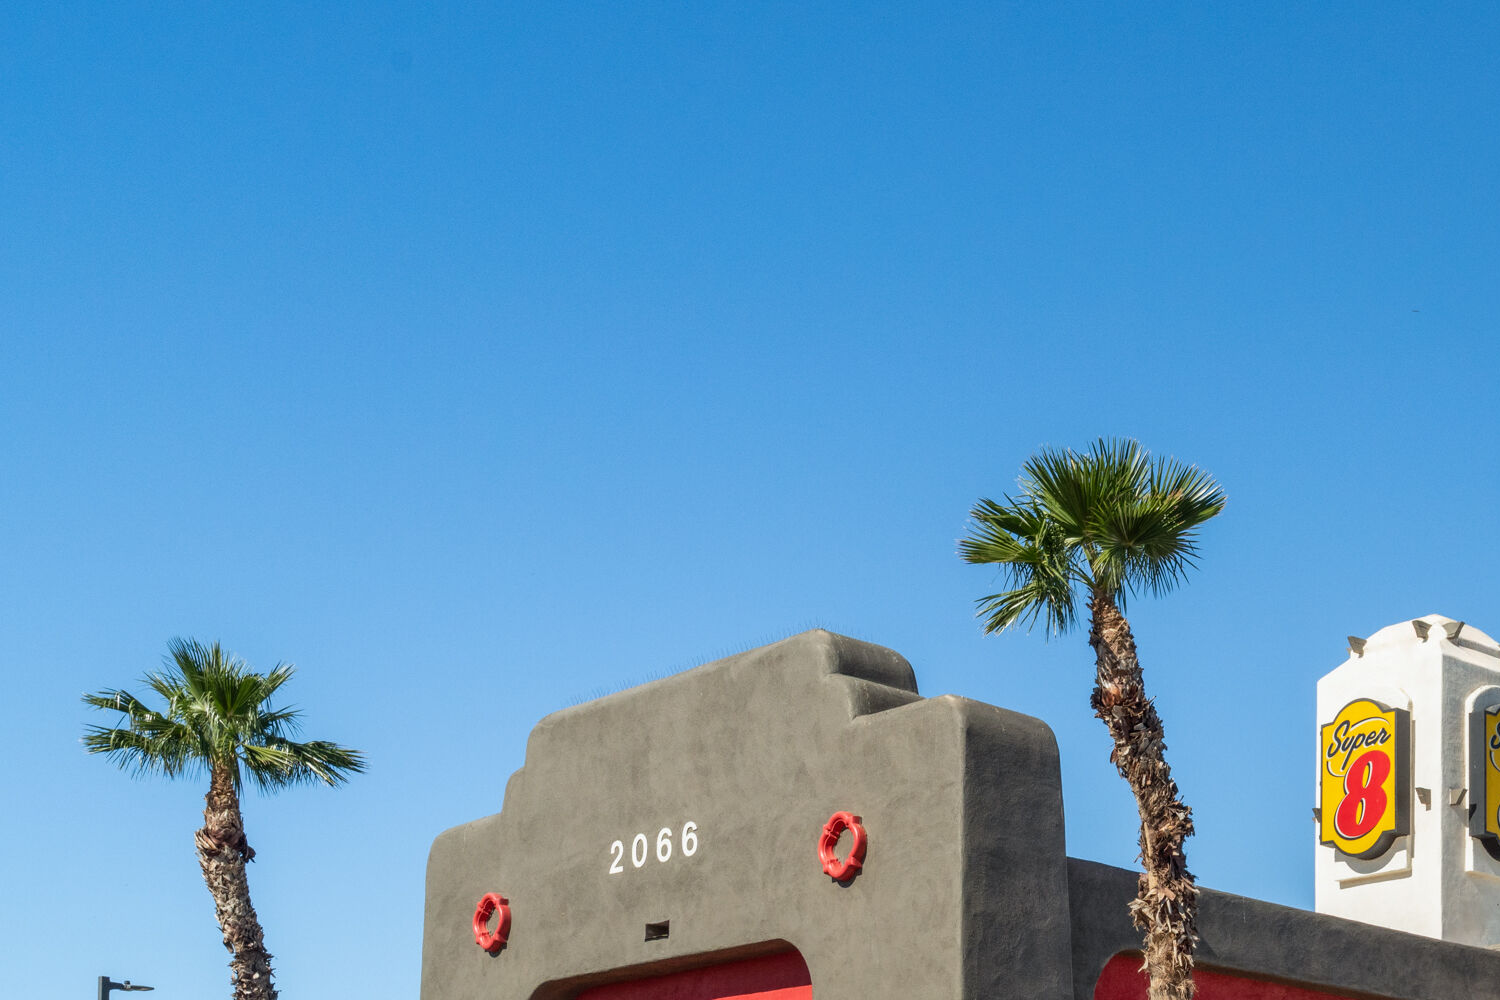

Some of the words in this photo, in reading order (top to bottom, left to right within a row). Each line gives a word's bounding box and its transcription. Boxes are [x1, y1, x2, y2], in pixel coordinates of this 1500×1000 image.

[1327, 719, 1392, 771] Super
[1333, 749, 1391, 841] 8
[609, 820, 698, 875] 2066
